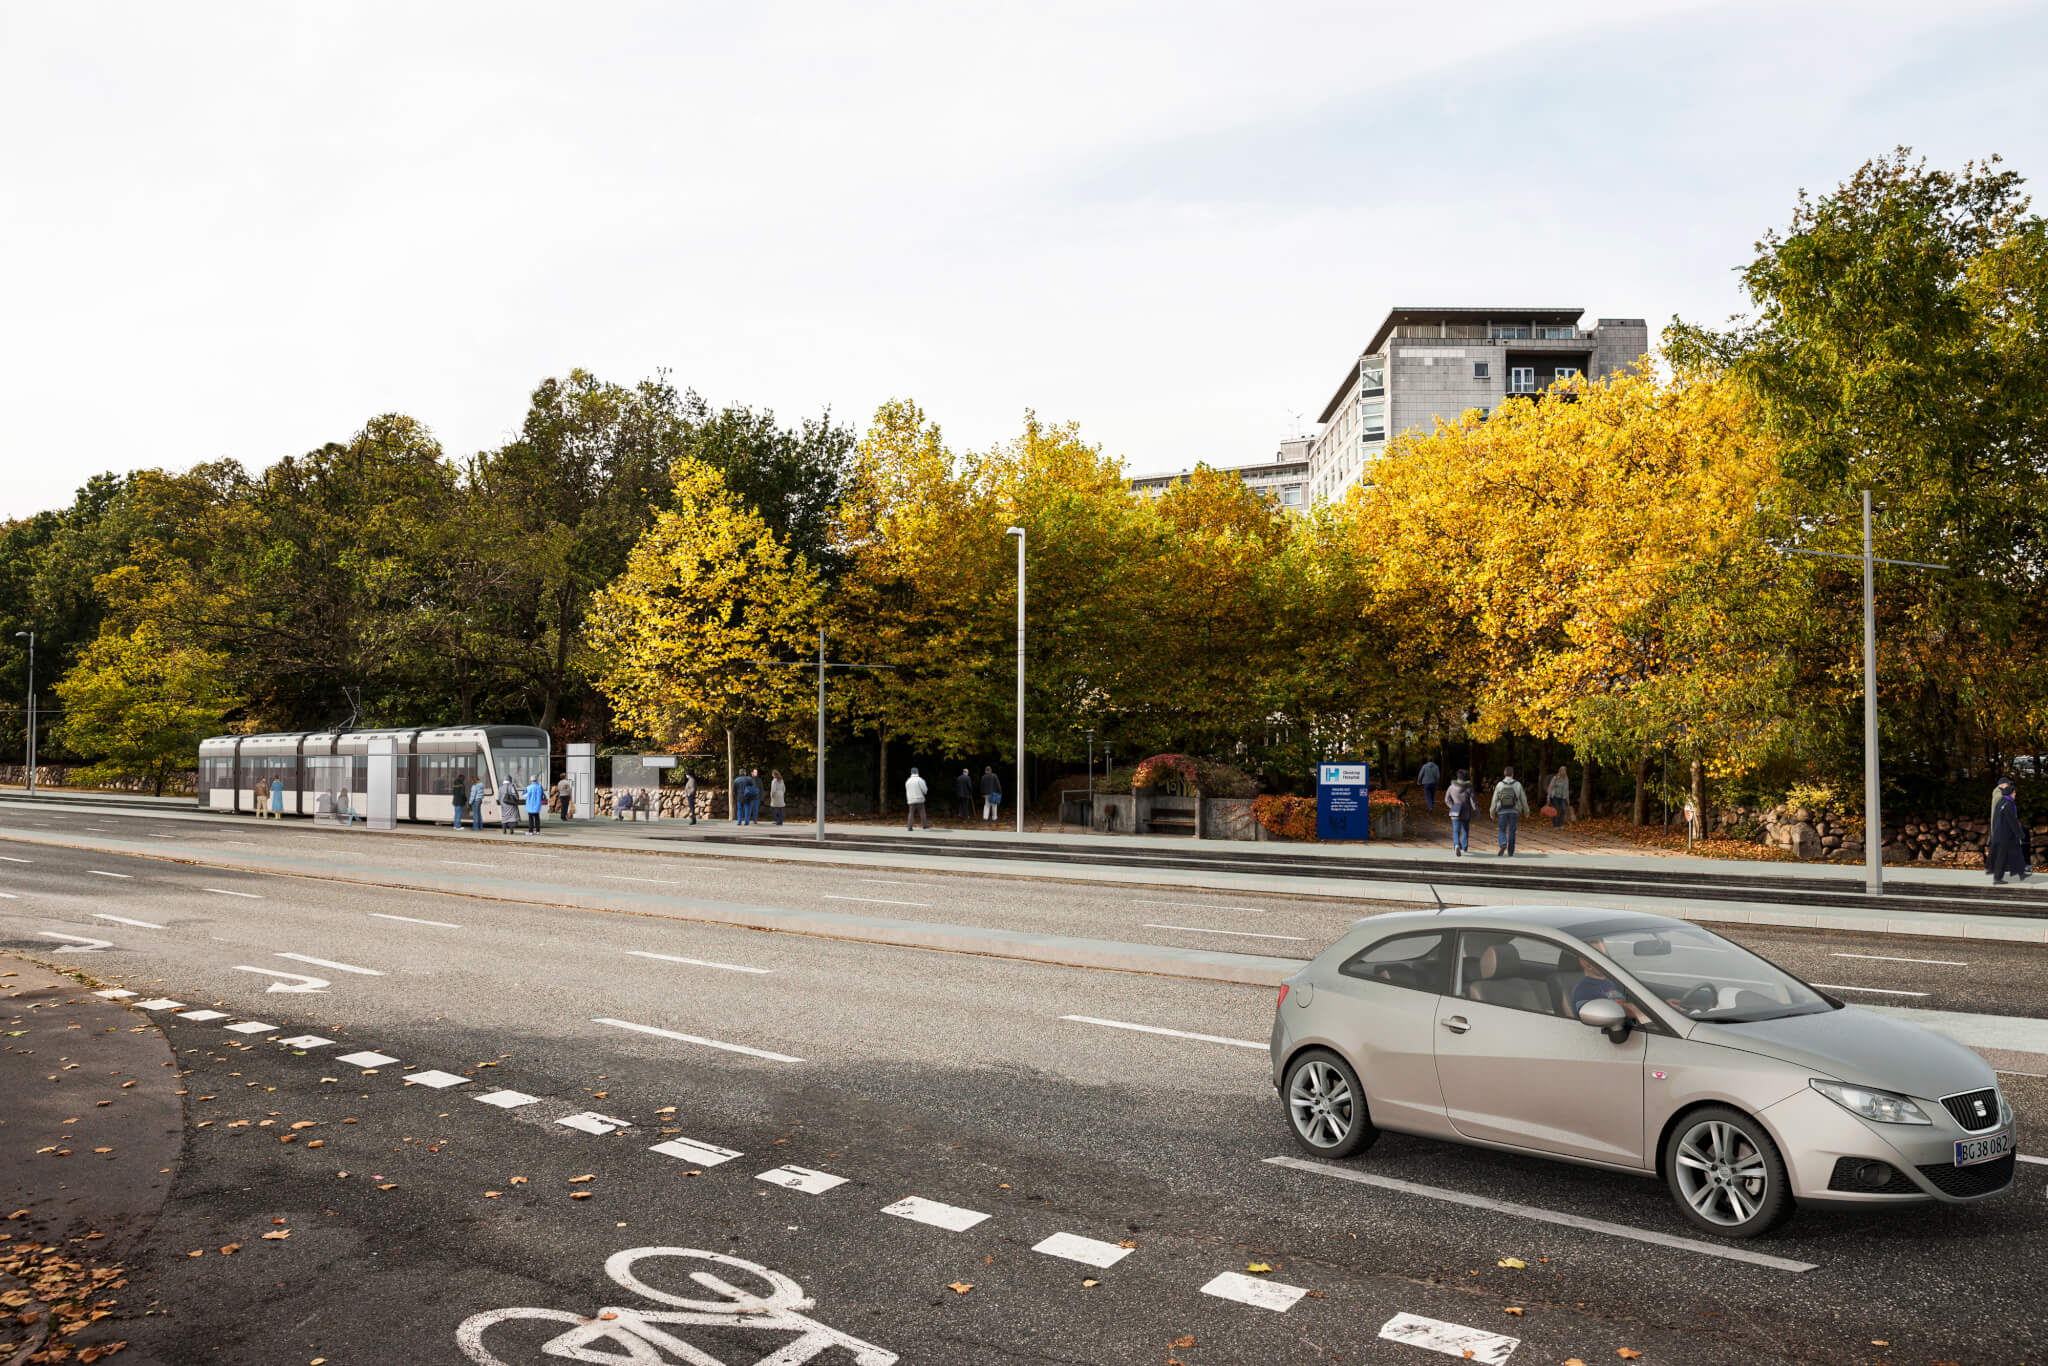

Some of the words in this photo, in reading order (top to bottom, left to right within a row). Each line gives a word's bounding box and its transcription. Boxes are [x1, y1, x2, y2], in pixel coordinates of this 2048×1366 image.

[1962, 1144, 1975, 1161] BG
[1977, 1141, 1988, 1158] 38
[1990, 1135, 2008, 1154] 082
